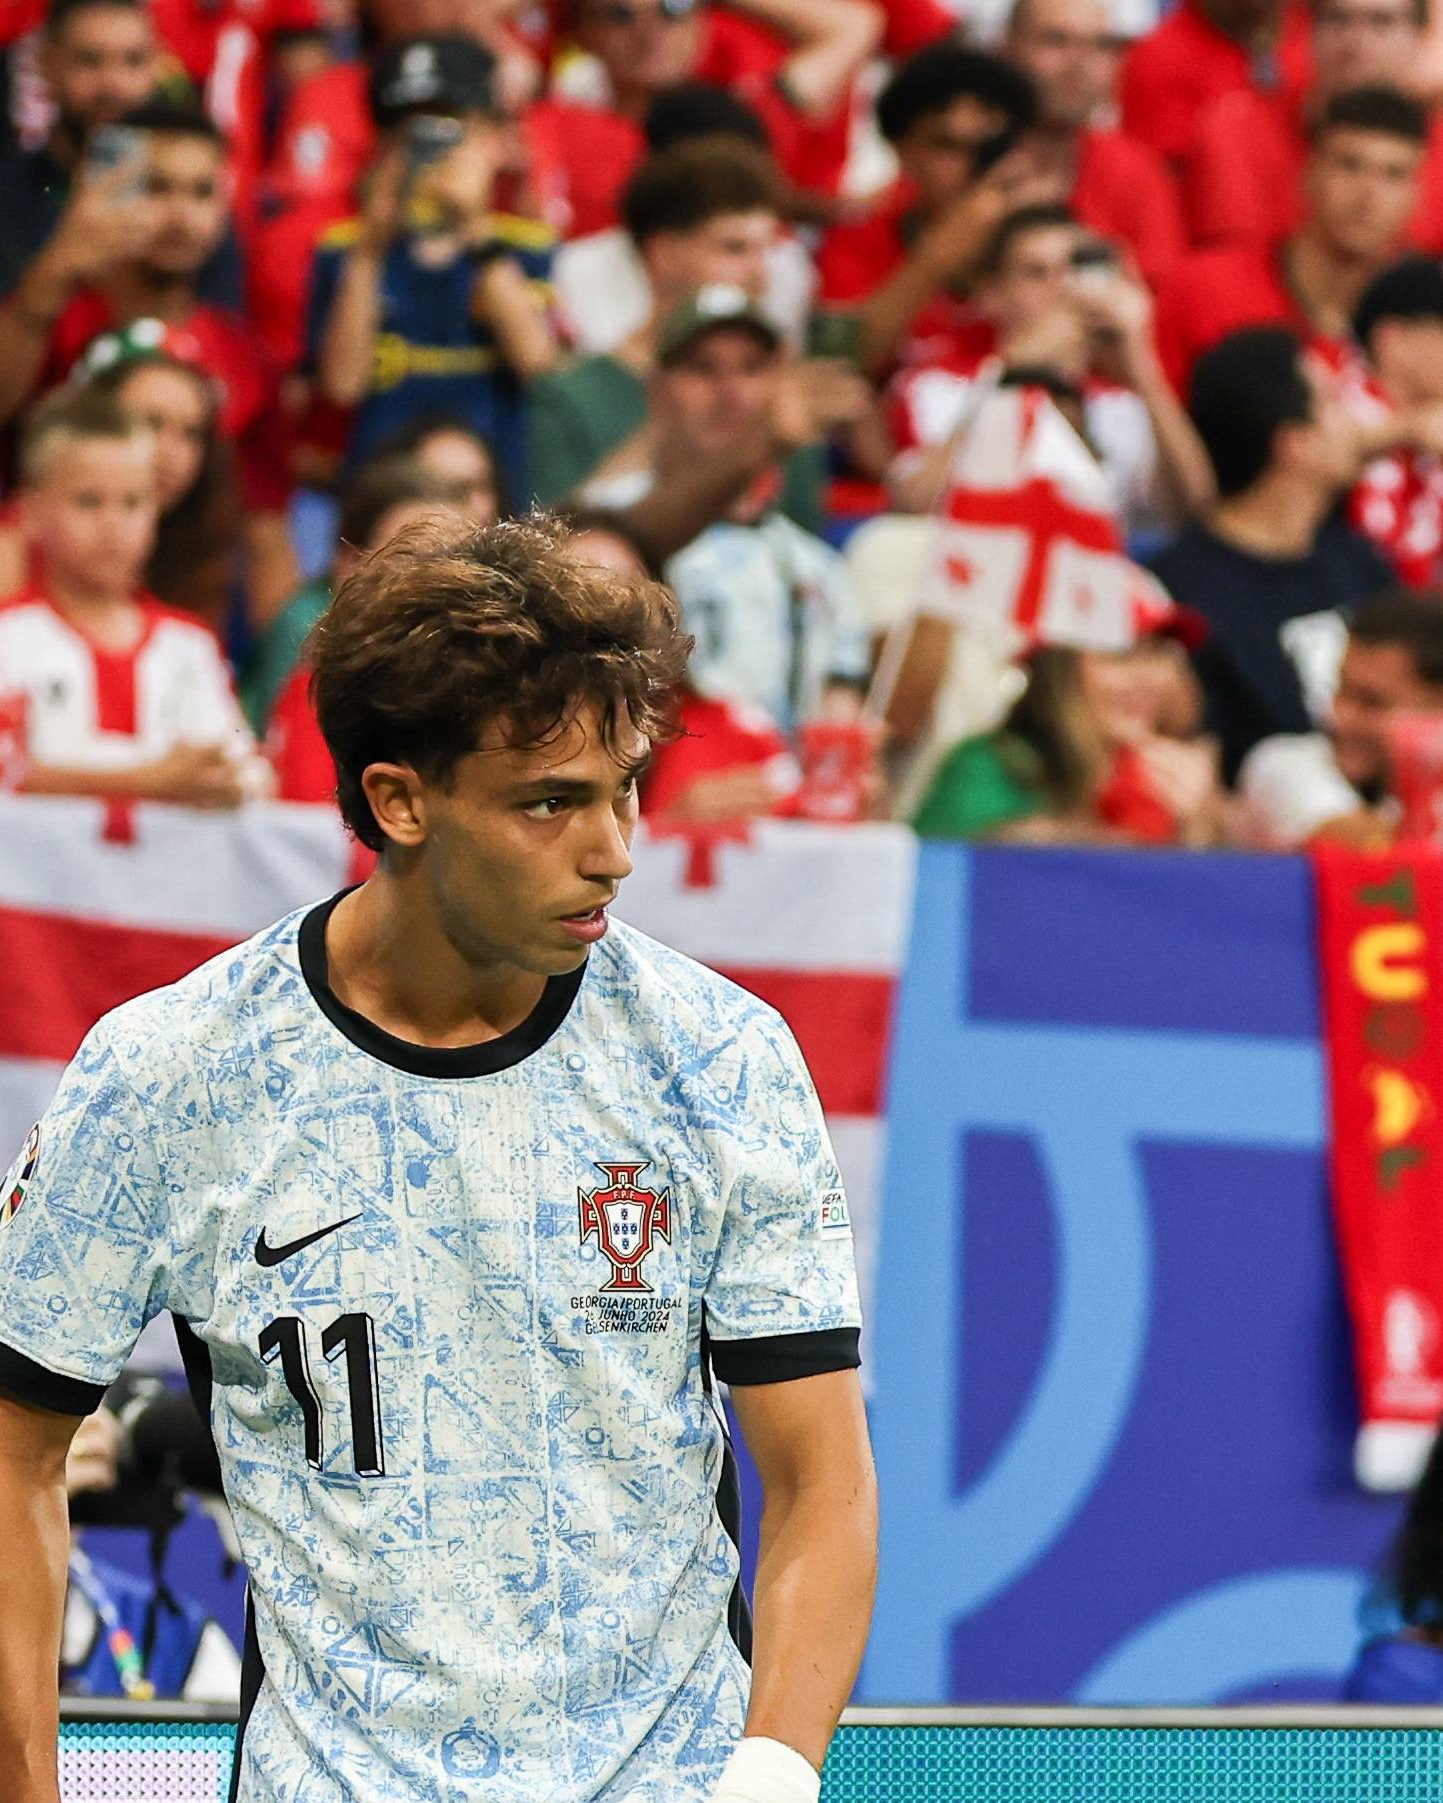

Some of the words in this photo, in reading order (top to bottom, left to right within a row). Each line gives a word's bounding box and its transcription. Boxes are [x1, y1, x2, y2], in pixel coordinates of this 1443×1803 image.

[570, 1295, 682, 1309] GEORGIA/PORTUGAL
[598, 1310, 636, 1321] JUNHO
[641, 1310, 670, 1322] 2024
[258, 1312, 386, 1478] 11
